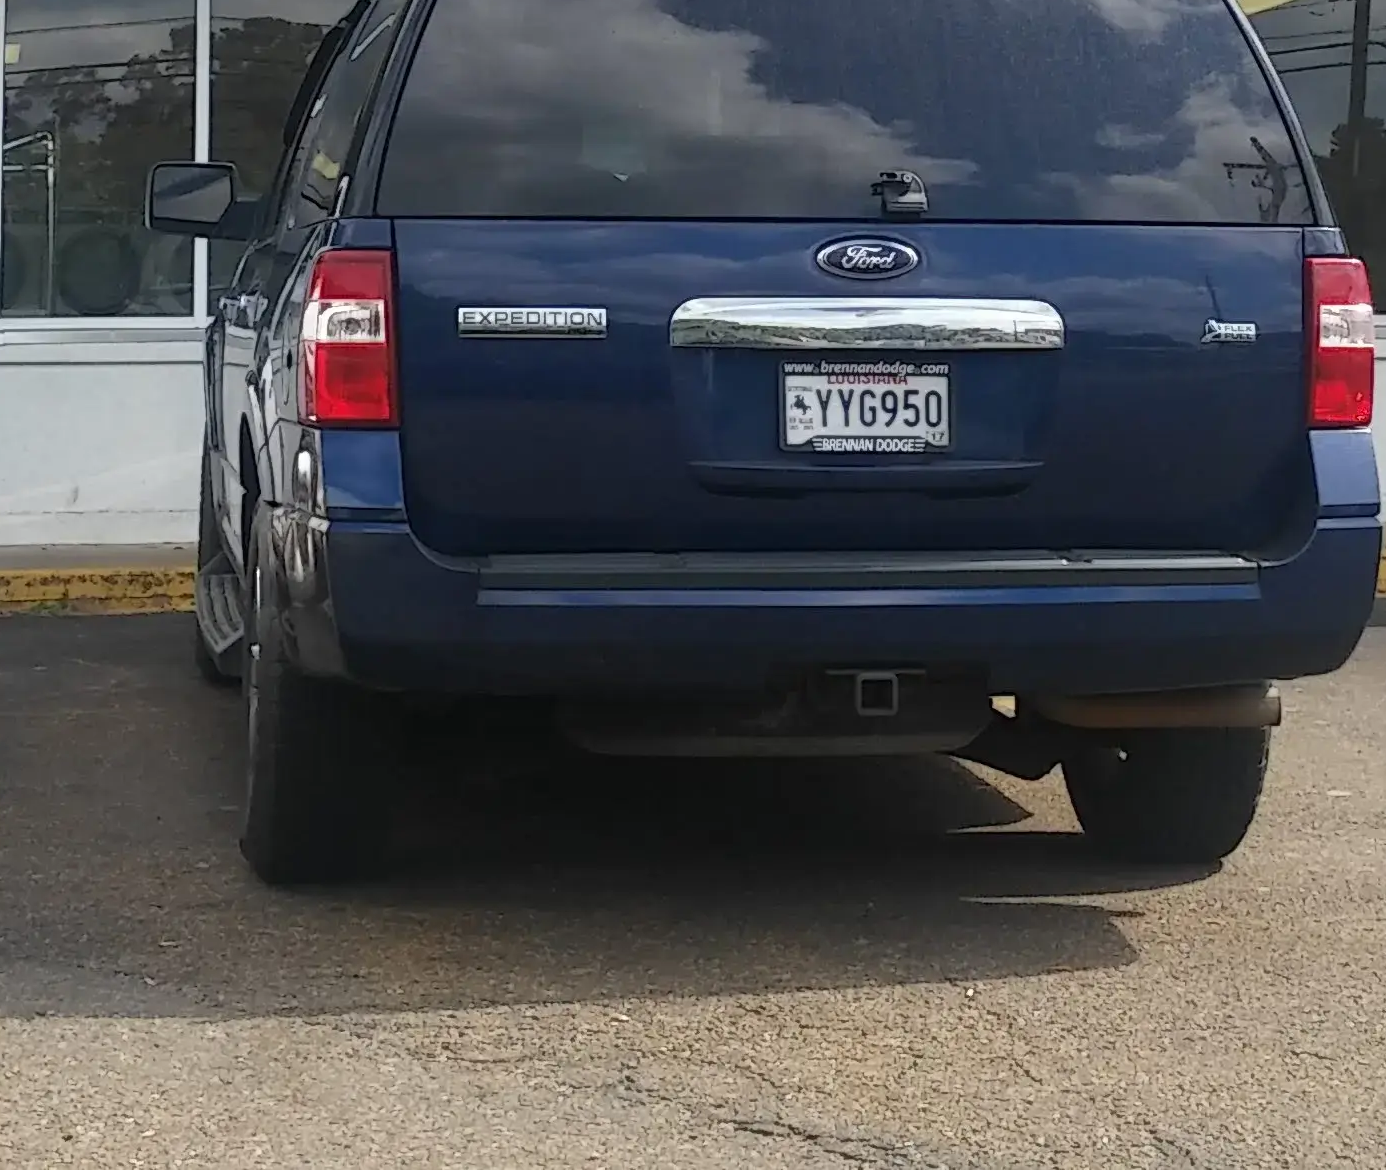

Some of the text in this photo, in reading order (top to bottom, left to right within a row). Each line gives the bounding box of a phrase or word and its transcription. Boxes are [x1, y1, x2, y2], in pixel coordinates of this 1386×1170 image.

[842, 245, 896, 270] Ford
[461, 310, 604, 326] EXPEDITION
[815, 388, 942, 428] YYG950
[822, 438, 914, 452] BRENNAN DODGE
